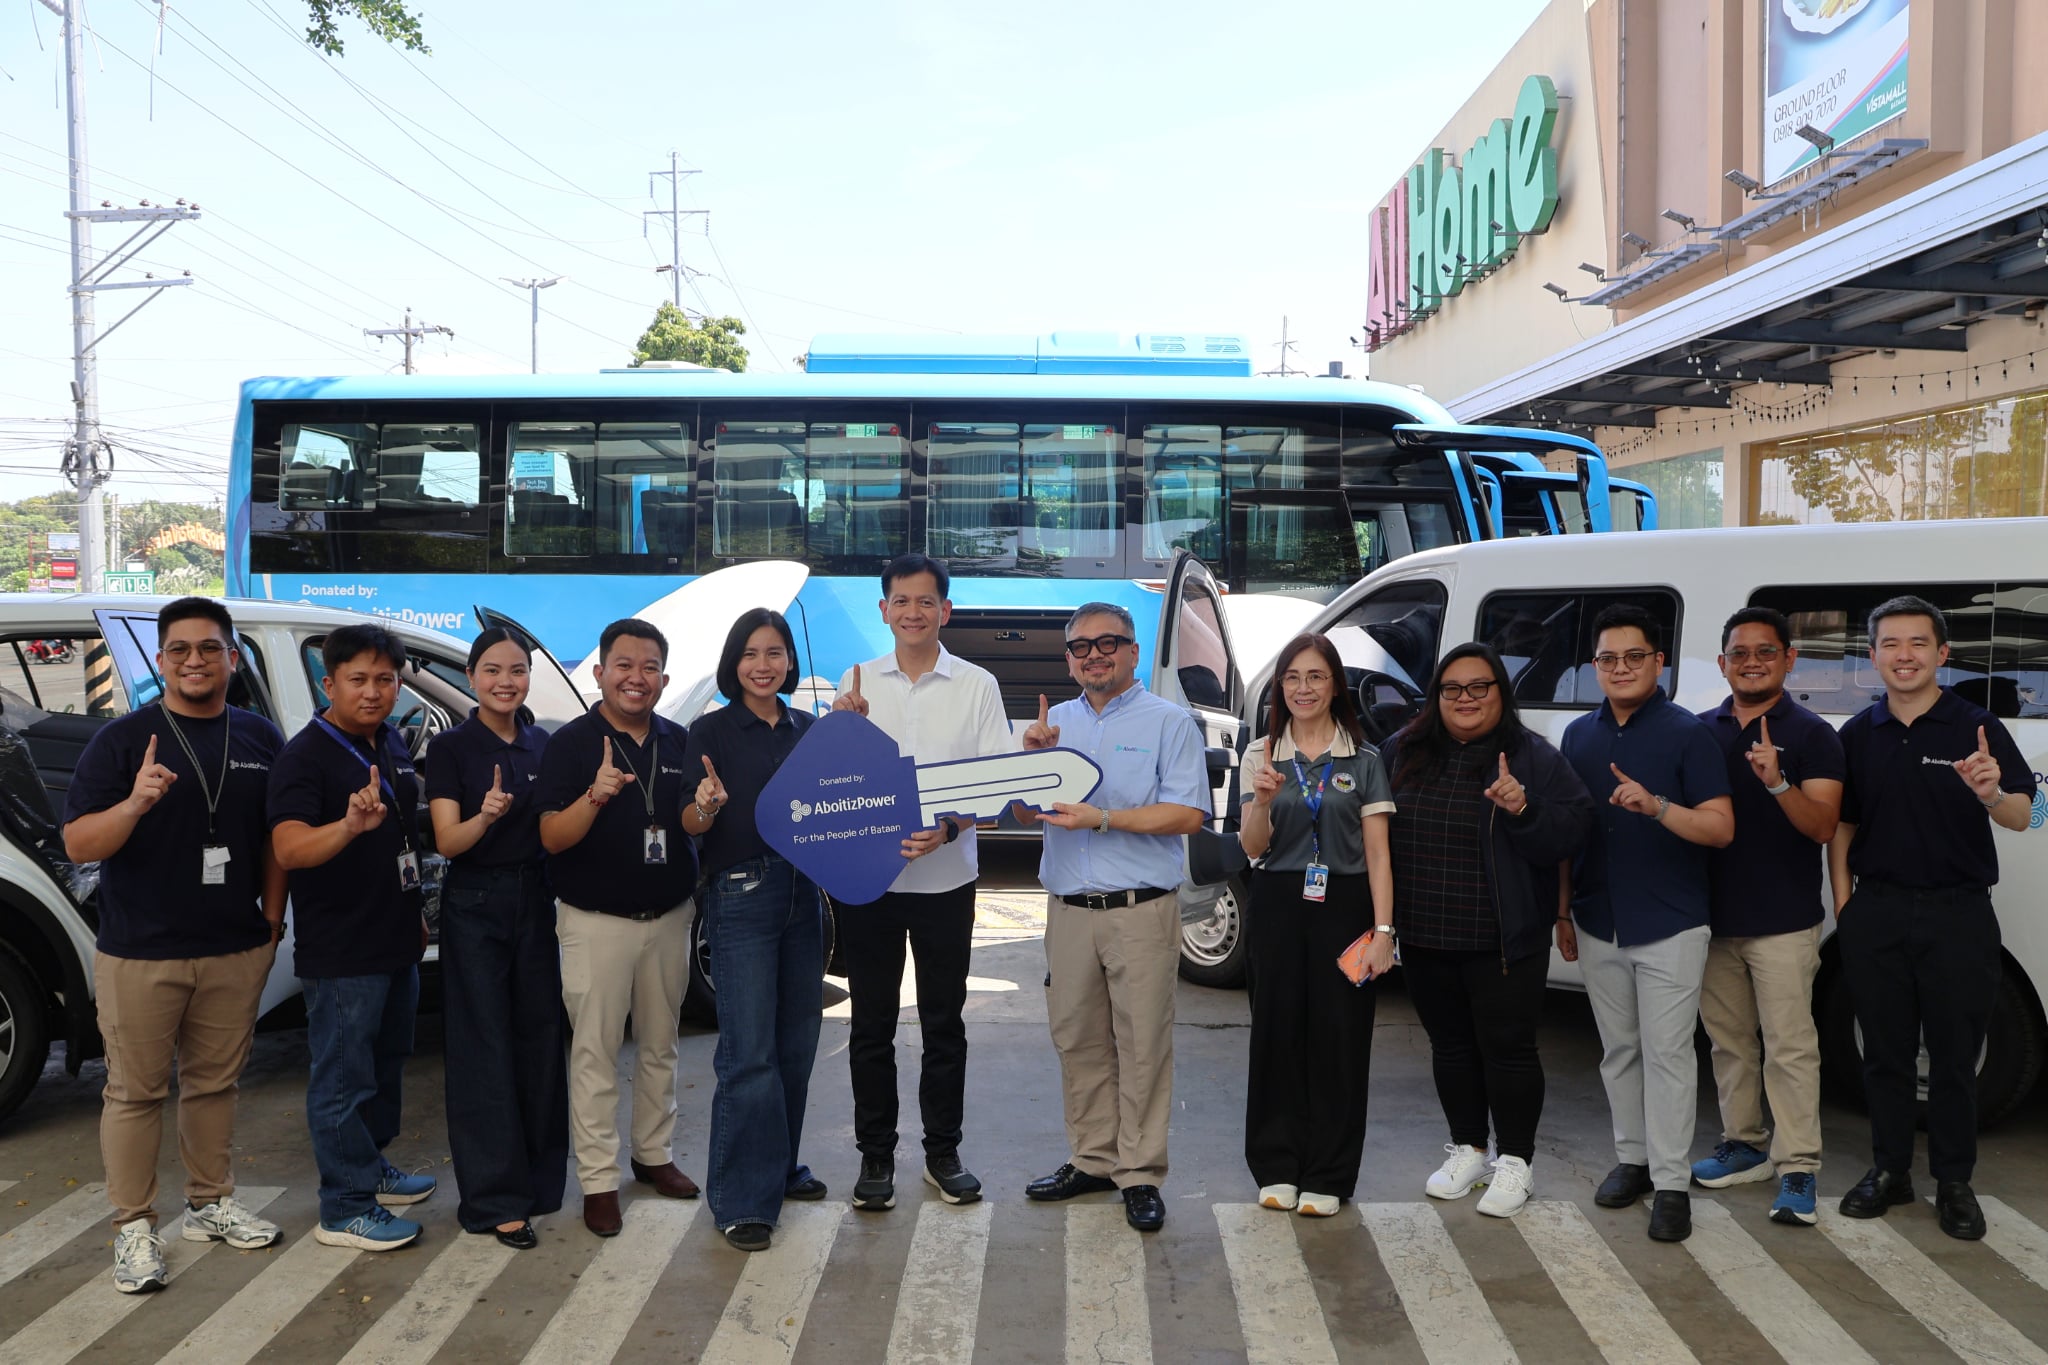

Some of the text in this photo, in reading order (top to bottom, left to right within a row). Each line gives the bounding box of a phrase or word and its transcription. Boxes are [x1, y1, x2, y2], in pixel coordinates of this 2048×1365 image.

[1774, 68, 1847, 123] GROUND FLOOR
[1773, 120, 1793, 143] 0918
[1816, 95, 1837, 121] 7070
[302, 584, 378, 599] Donated by:
[819, 774, 866, 786] Donated by:
[814, 794, 896, 815] AboitizPower
[793, 823, 901, 845] For the People of Bataan
